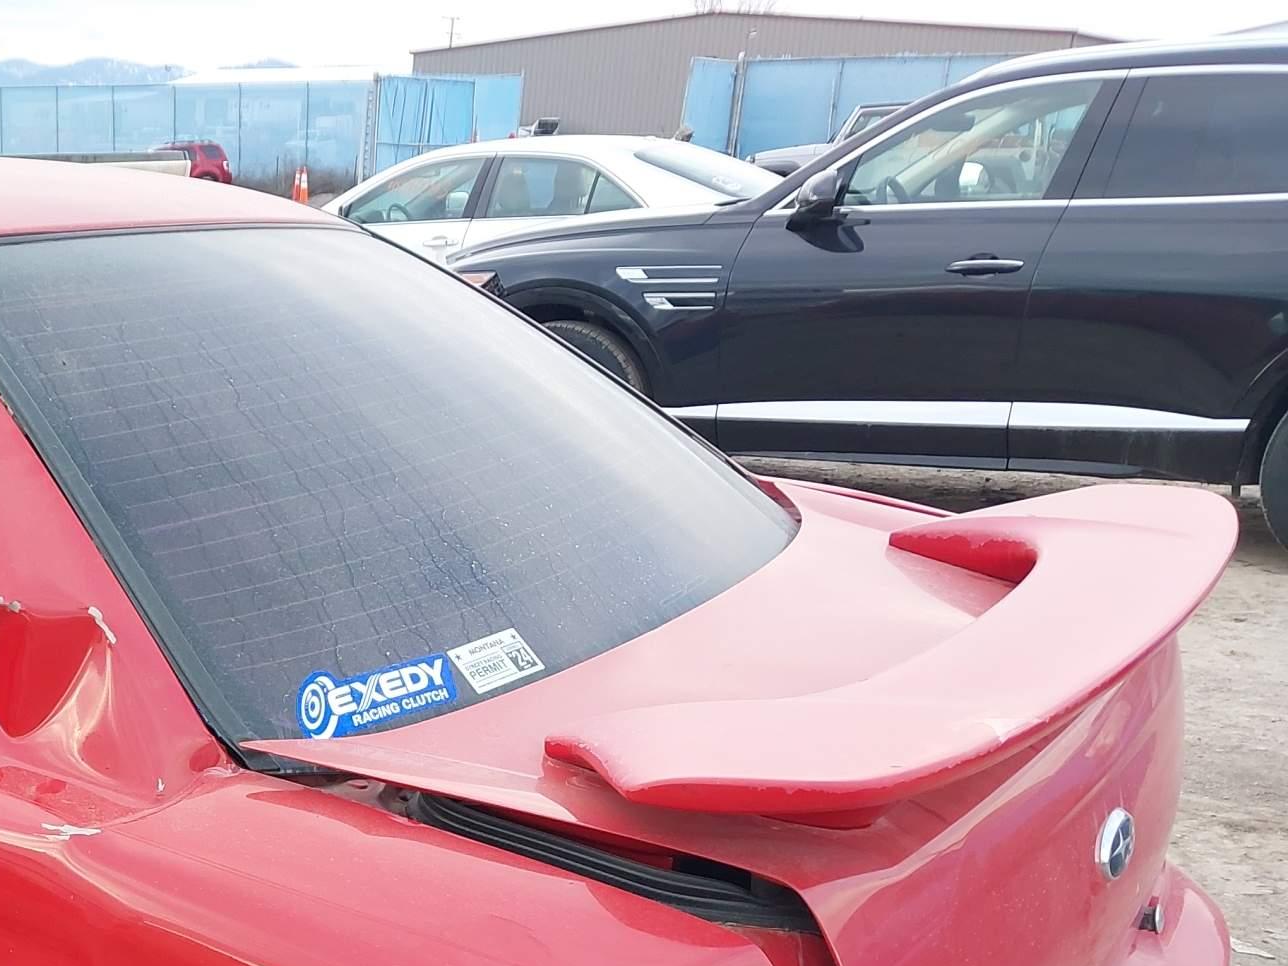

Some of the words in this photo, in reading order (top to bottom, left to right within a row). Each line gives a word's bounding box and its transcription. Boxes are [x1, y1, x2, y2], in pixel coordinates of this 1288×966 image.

[468, 639, 504, 656] MONTANA
[469, 659, 508, 680] PERMIT
[327, 658, 443, 716] EXEDY
[351, 703, 401, 726] RACING
[402, 688, 449, 710] CLUTCH
